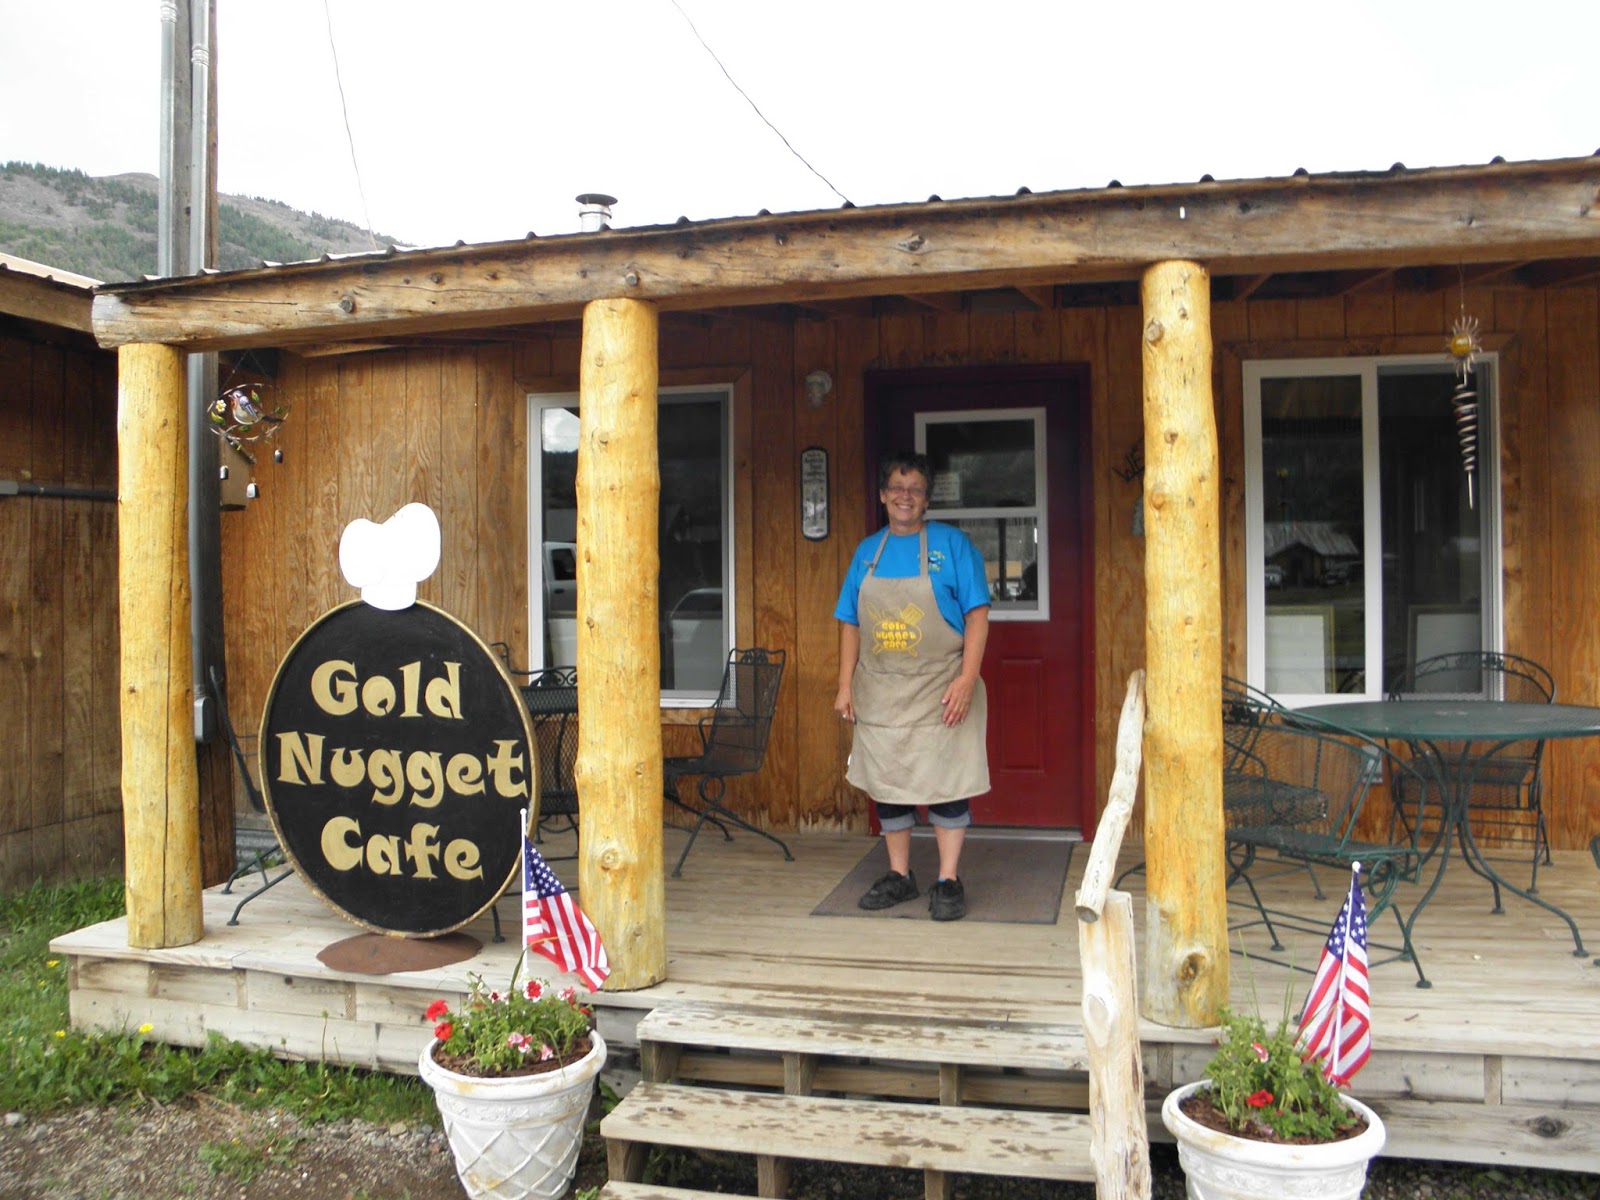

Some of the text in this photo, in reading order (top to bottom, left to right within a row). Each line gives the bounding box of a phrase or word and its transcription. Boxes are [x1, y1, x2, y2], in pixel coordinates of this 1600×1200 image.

[311, 659, 464, 719] Gold
[275, 730, 528, 808] Nugget
[320, 815, 484, 881] Cafe
